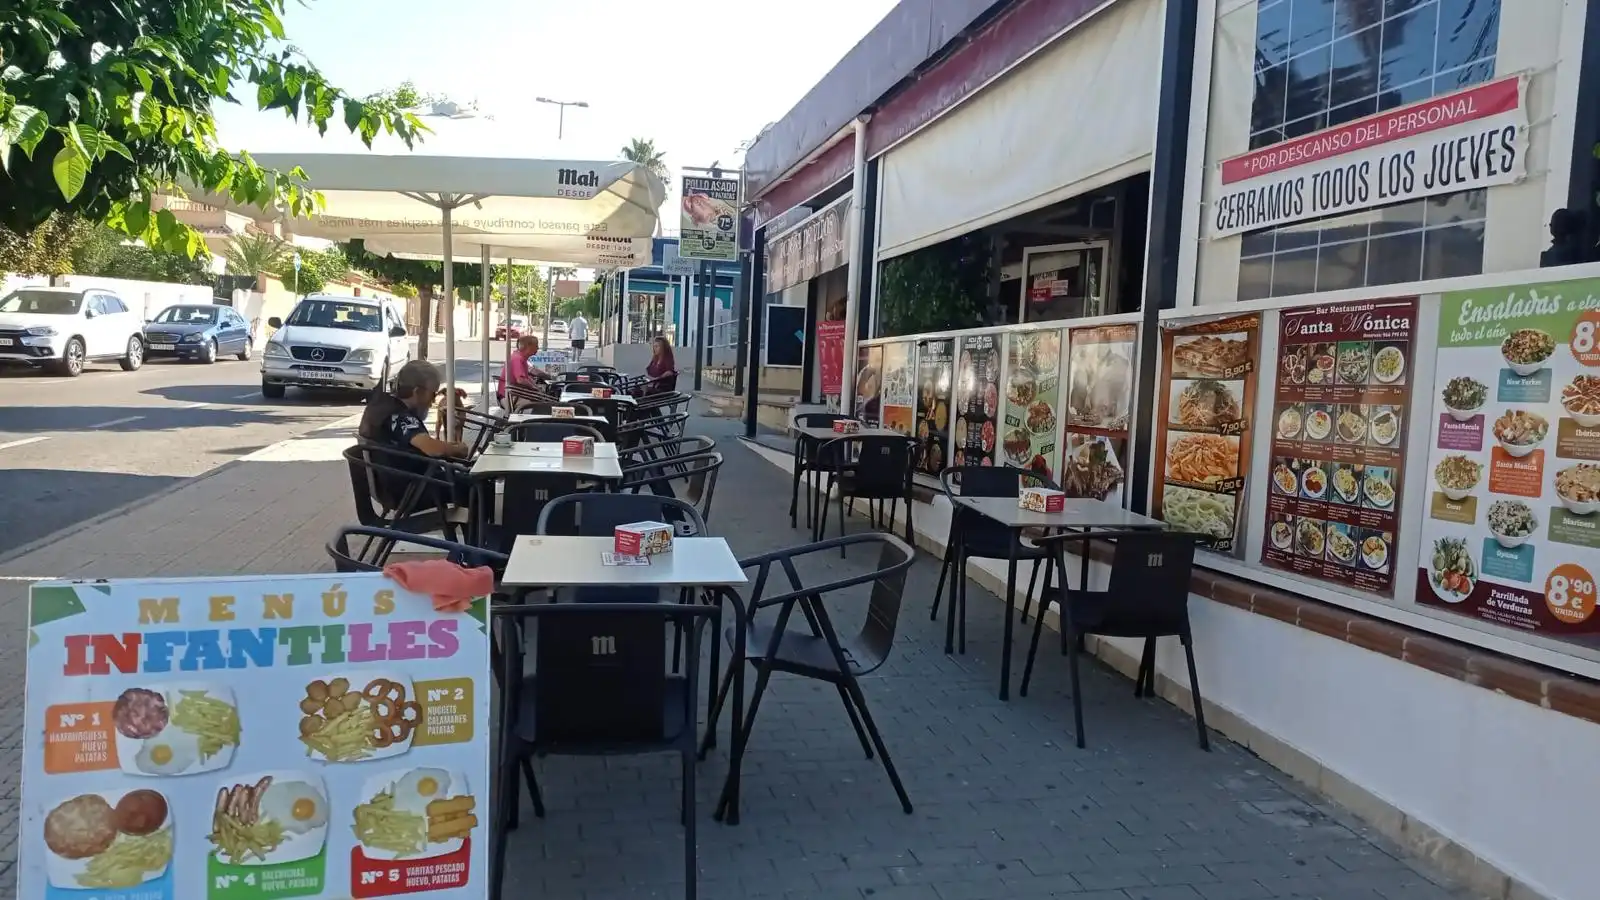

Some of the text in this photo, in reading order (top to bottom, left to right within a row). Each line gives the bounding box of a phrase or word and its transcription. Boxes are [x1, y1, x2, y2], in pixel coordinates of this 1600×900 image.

[1278, 129, 1352, 166] DESCANSO
[1355, 123, 1382, 143] DEL
[1387, 95, 1478, 136] PERSONAL
[685, 178, 737, 192] POLLO ASADO
[1215, 125, 1516, 231] CERRAMOS TODOS LOS JUEVES
[557, 188, 592, 198] DESDE
[1315, 303, 1375, 315] Bar Restaurante
[1457, 288, 1562, 326] Ensaladas
[1567, 300, 1576, 311] a
[1285, 311, 1410, 337] Santa Mónica
[1451, 323, 1508, 342] todo el año
[1224, 362, 1252, 378] 8,90 €
[1221, 420, 1246, 435] 7,90 €
[1216, 481, 1235, 493] 7,90
[1491, 589, 1529, 605] Parrillada
[1486, 597, 1533, 616] de Verduras
[63, 619, 460, 677] INFANTILES
[453, 687, 464, 700] 2
[91, 712, 100, 726] 1
[427, 725, 455, 736] PATATAS
[82, 740, 107, 752] HUEVO
[74, 752, 108, 763] PATATAS
[388, 868, 400, 882] 5
[406, 862, 465, 877] VARITAS PESCADO
[243, 872, 256, 886] 4
[431, 873, 460, 885] PATATAS
